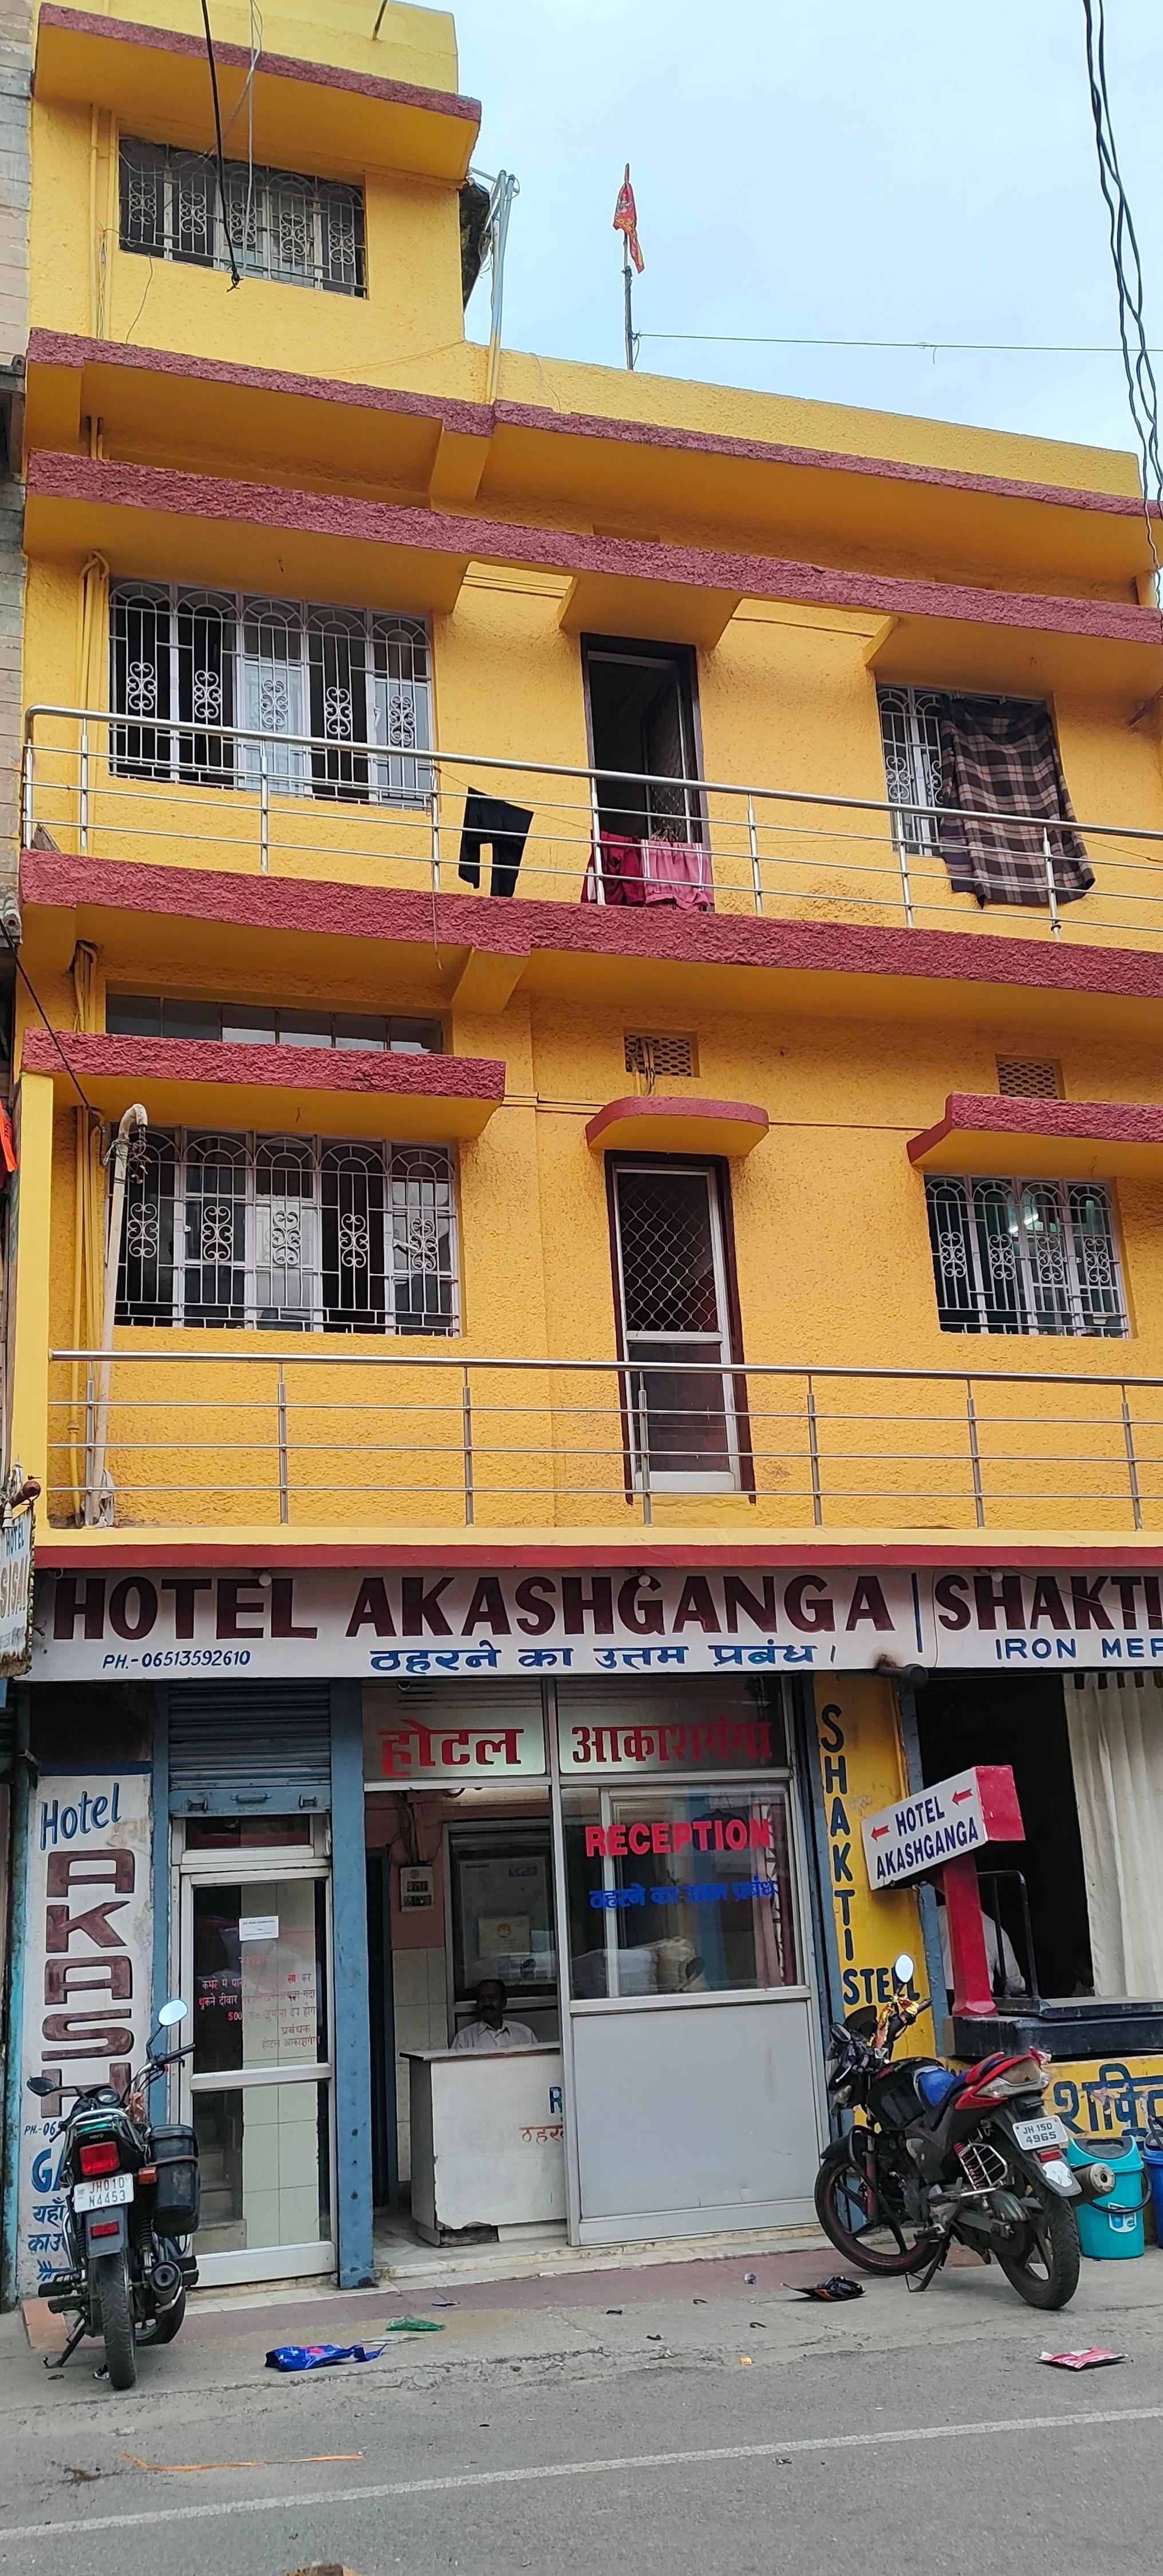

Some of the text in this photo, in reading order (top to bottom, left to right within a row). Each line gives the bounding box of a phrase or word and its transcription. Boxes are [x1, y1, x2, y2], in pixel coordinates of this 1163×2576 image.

[6, 1520, 25, 1556] HOTEL
[53, 1577, 318, 1639] HOTEL
[345, 1574, 896, 1637] AKASHGANGA
[935, 1574, 1163, 1631] SHAKTI
[102, 1650, 251, 1669] PH.-06513592610
[369, 1639, 502, 1674] ठहरने
[518, 1647, 574, 1668] का
[593, 1645, 689, 1670] उत्तम
[708, 1639, 818, 1667] प्रबंध
[995, 1638, 1077, 1660] IRON
[377, 1718, 525, 1776] होटल
[40, 1782, 122, 1851] Hotel
[821, 1704, 856, 1961] SHAKTI
[894, 1795, 946, 1837] HOTEL
[585, 1818, 771, 1857] RECEPTION
[877, 1816, 979, 1880] AKASHGANGA
[41, 1848, 136, 2118] AKASH
[219, 1992, 238, 2006] दीवार
[228, 2011, 243, 2021] 500
[519, 2124, 563, 2147] ठहर
[1023, 2122, 1053, 2135] JH 15D
[1026, 2131, 1057, 2144] 4965
[89, 2177, 125, 2194] JH01D
[89, 2190, 126, 2208] N4453
[27, 2234, 66, 2253] काउ
